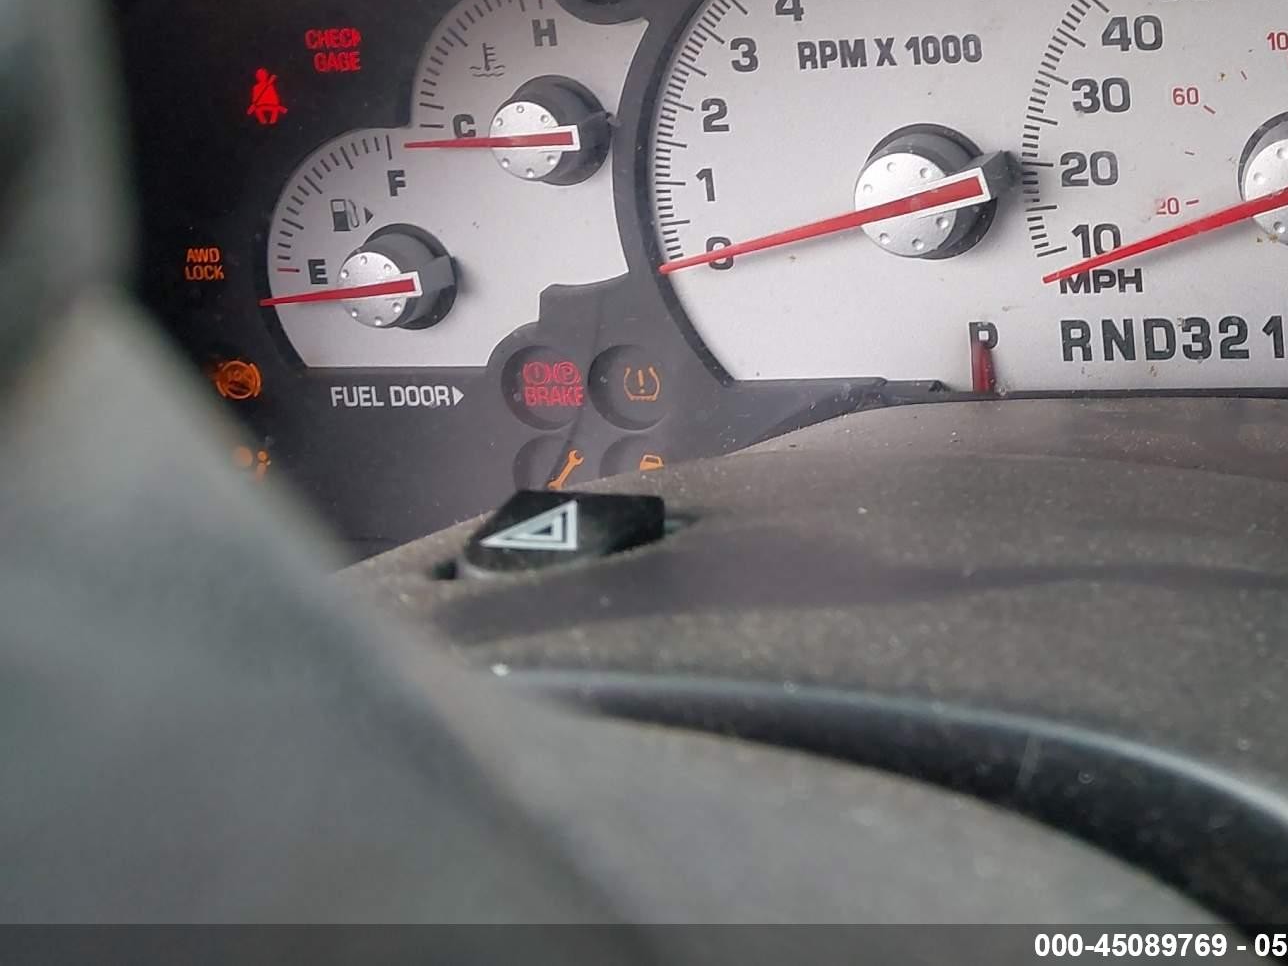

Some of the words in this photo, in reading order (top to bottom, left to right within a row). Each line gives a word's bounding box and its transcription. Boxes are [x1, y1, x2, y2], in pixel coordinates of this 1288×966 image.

[532, 20, 557, 46] H
[1101, 15, 1163, 51] 40
[729, 37, 759, 72] 3
[798, 40, 867, 69] RPM
[874, 37, 897, 66] X
[904, 34, 982, 65] 1000
[1072, 79, 1131, 113] 30
[1173, 87, 1199, 105] 60
[453, 115, 476, 137] C
[701, 99, 729, 133] 2
[1060, 152, 1118, 186] 20
[388, 170, 406, 196] F
[695, 168, 715, 202] 1
[1072, 223, 1122, 258] 10
[187, 247, 220, 263] AWD
[184, 265, 225, 280] LOCK
[308, 259, 328, 285] E
[1060, 268, 1143, 294] MPH
[1060, 316, 1285, 362] RND321
[330, 386, 384, 407] FUEL
[390, 385, 450, 407] DOOR
[524, 386, 584, 406] BRAKE
